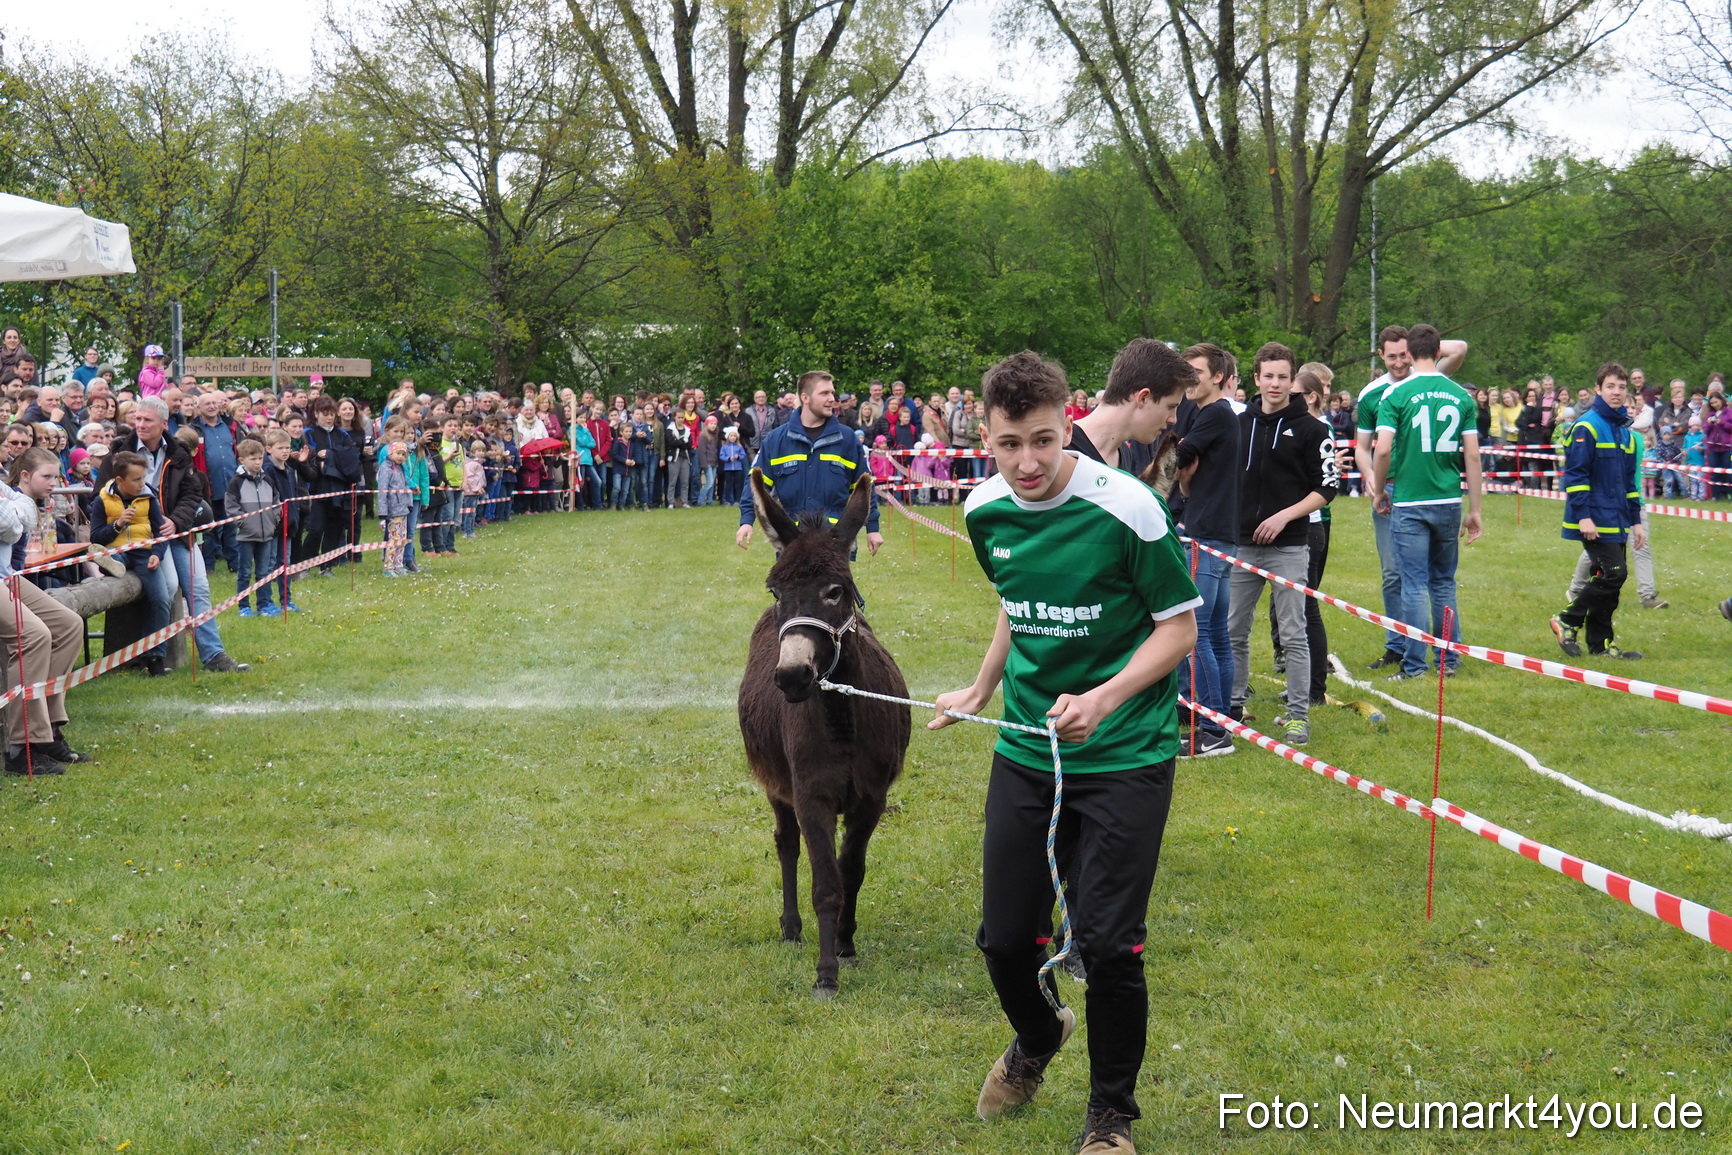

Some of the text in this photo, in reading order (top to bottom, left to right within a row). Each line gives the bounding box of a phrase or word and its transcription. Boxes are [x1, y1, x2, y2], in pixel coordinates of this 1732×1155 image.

[1410, 391, 1461, 405] SV Pölling
[1411, 404, 1461, 453] 12
[993, 546, 1011, 559] JAKO
[1035, 601, 1103, 624] Seger
